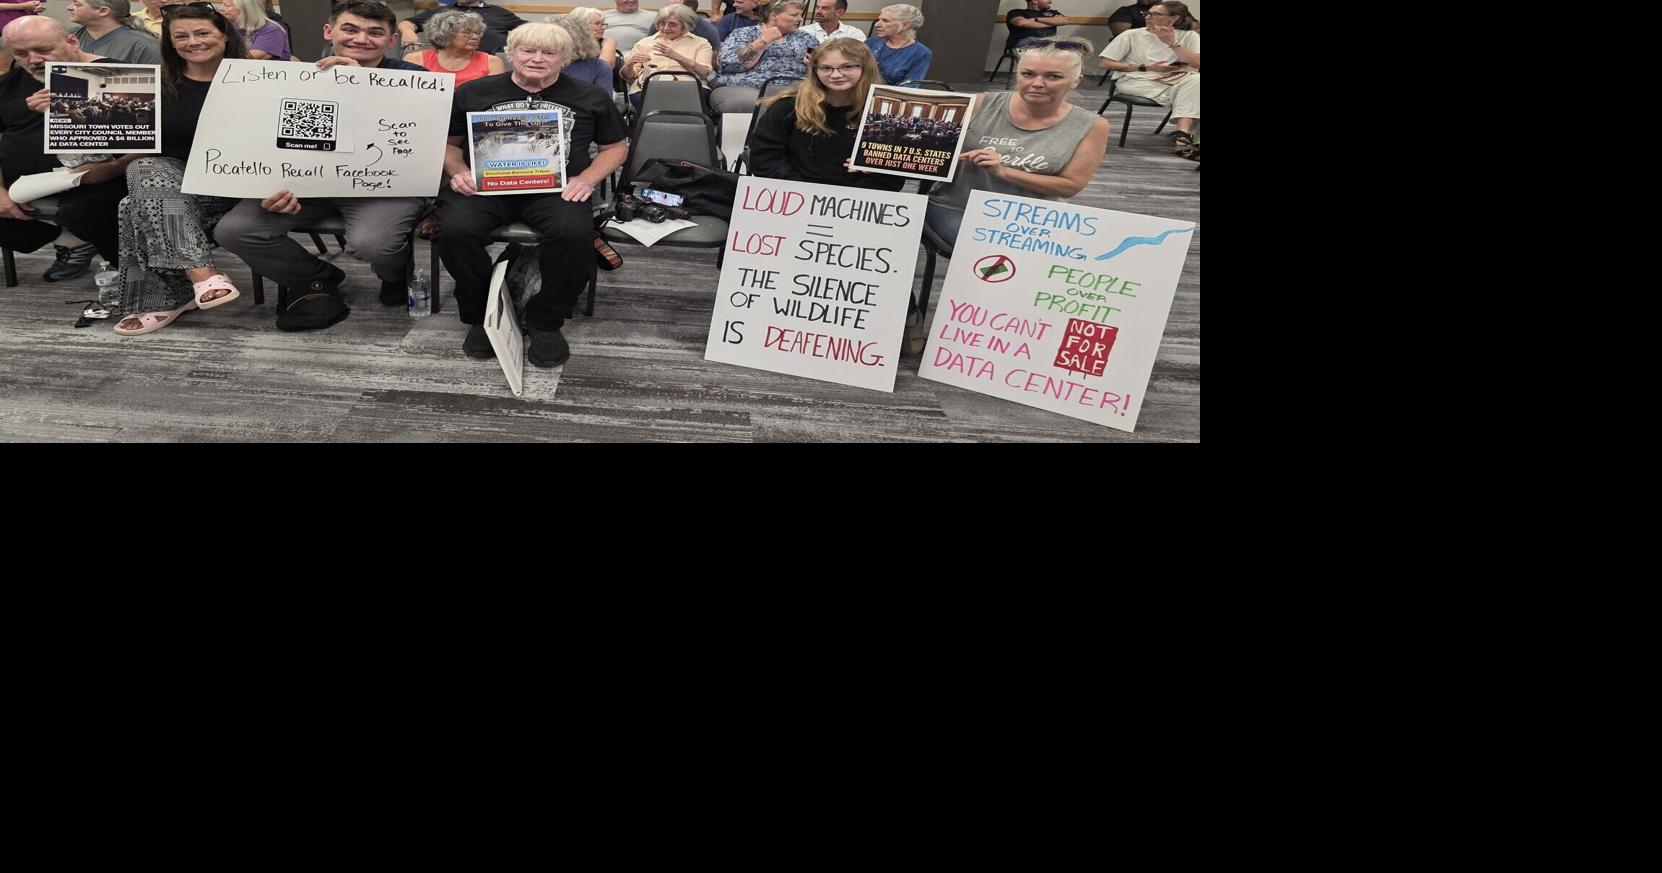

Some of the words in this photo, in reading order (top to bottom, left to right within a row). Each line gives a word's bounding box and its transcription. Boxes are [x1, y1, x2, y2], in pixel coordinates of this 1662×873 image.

[222, 64, 287, 84] Listen
[300, 70, 323, 81] or
[334, 69, 360, 85] be
[369, 72, 446, 92] Recalled!
[496, 103, 513, 111] WHAT
[378, 118, 417, 131] Scan
[868, 142, 892, 151] TOWNS
[894, 145, 902, 153] IN
[909, 147, 922, 156] U.S.
[924, 149, 951, 159] STATES
[979, 136, 1017, 146] FREE
[205, 148, 272, 175] Pocatello
[281, 162, 324, 178] Recall
[336, 164, 399, 177] Facebook
[863, 149, 892, 159] BANNED
[893, 152, 911, 162] DATA
[912, 155, 945, 166] CENTERS
[865, 157, 883, 165] OVER
[884, 159, 900, 168] JUST
[902, 161, 917, 170] ONE
[918, 163, 938, 173] WEEK
[352, 178, 392, 191] Page!
[742, 186, 804, 216] LOUD
[810, 194, 910, 228] MACHINES
[983, 199, 1098, 236] STREAMS
[1006, 223, 1051, 238] OVER
[732, 231, 786, 256] LOST
[794, 239, 898, 274] SPECIES.
[738, 267, 780, 290] THE
[792, 274, 879, 306] SILENCE
[1048, 264, 1141, 297] PEOPLE
[1033, 291, 1121, 323] PROFIT
[1066, 287, 1107, 302] OVER
[730, 291, 760, 308] OF
[773, 297, 870, 330] WILDLIFE
[949, 299, 988, 324] YOU
[940, 324, 985, 347] LIVE
[987, 335, 1010, 354] IN
[1014, 342, 1032, 360] A
[1070, 320, 1113, 339] NOT
[722, 320, 744, 344] IS
[764, 325, 885, 366] DEAFENING.
[1066, 336, 1106, 358] FOR
[1057, 351, 1105, 375] SALE
[933, 346, 995, 380] DATA
[1004, 369, 1131, 417] CENTER!
